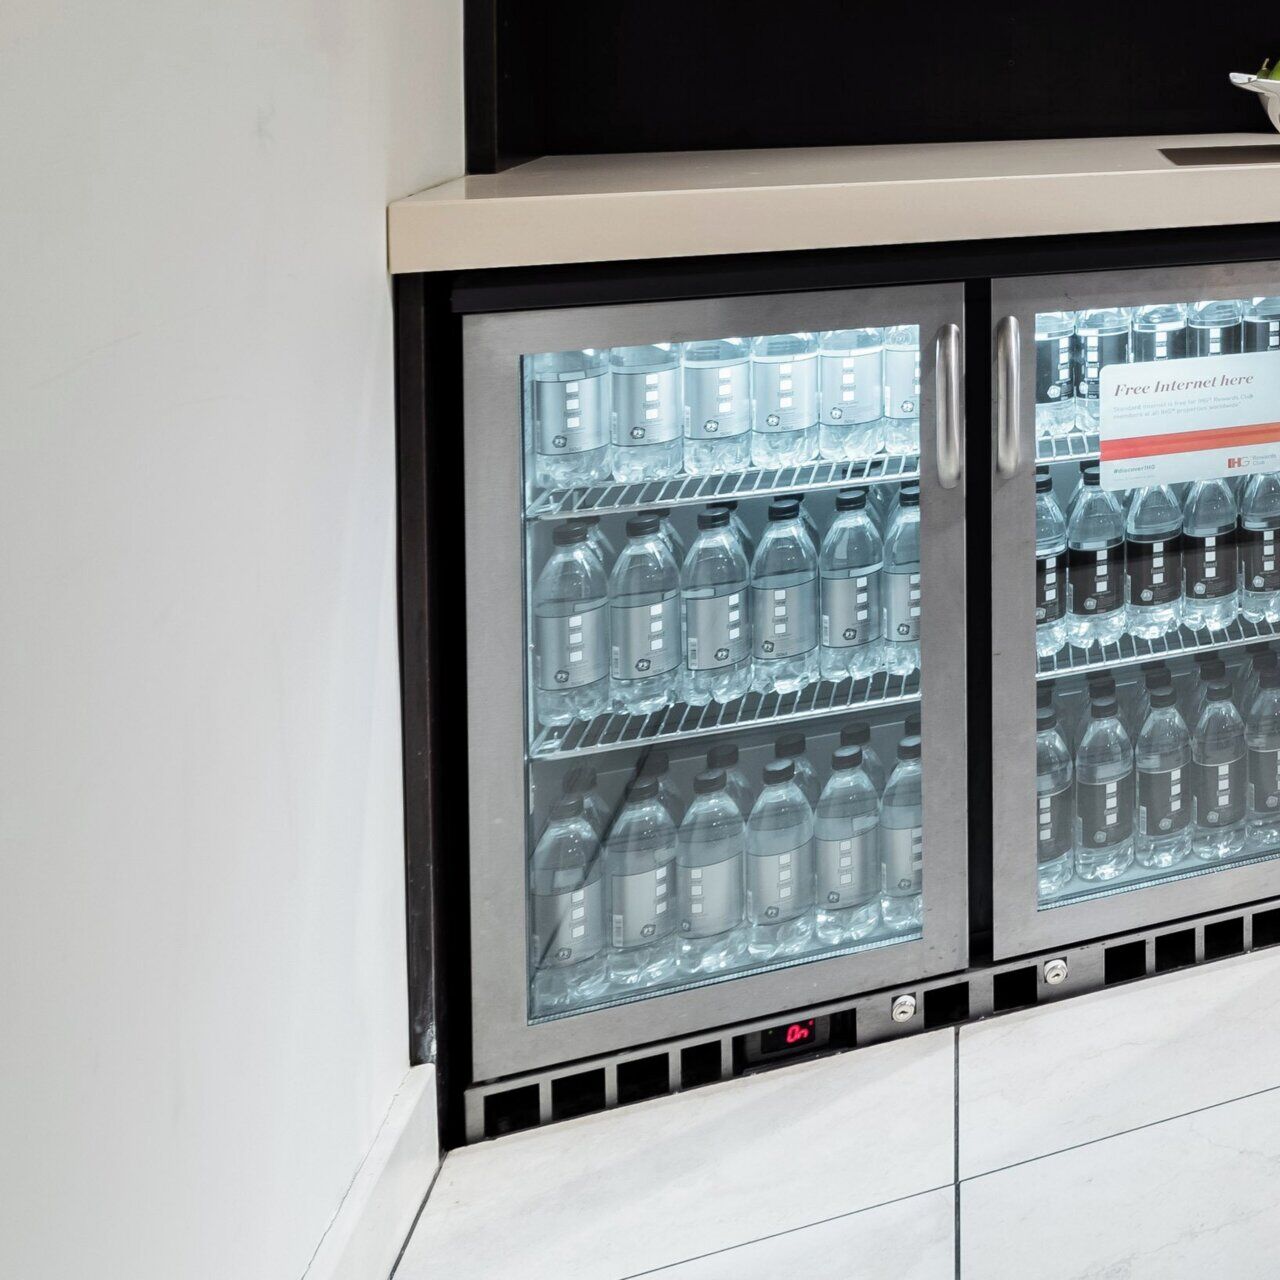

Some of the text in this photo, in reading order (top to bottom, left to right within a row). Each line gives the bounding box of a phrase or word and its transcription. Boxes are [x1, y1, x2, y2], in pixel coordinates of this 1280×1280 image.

[1114, 374, 1254, 397] Free Internet here
[1227, 456, 1250, 469] IHG
